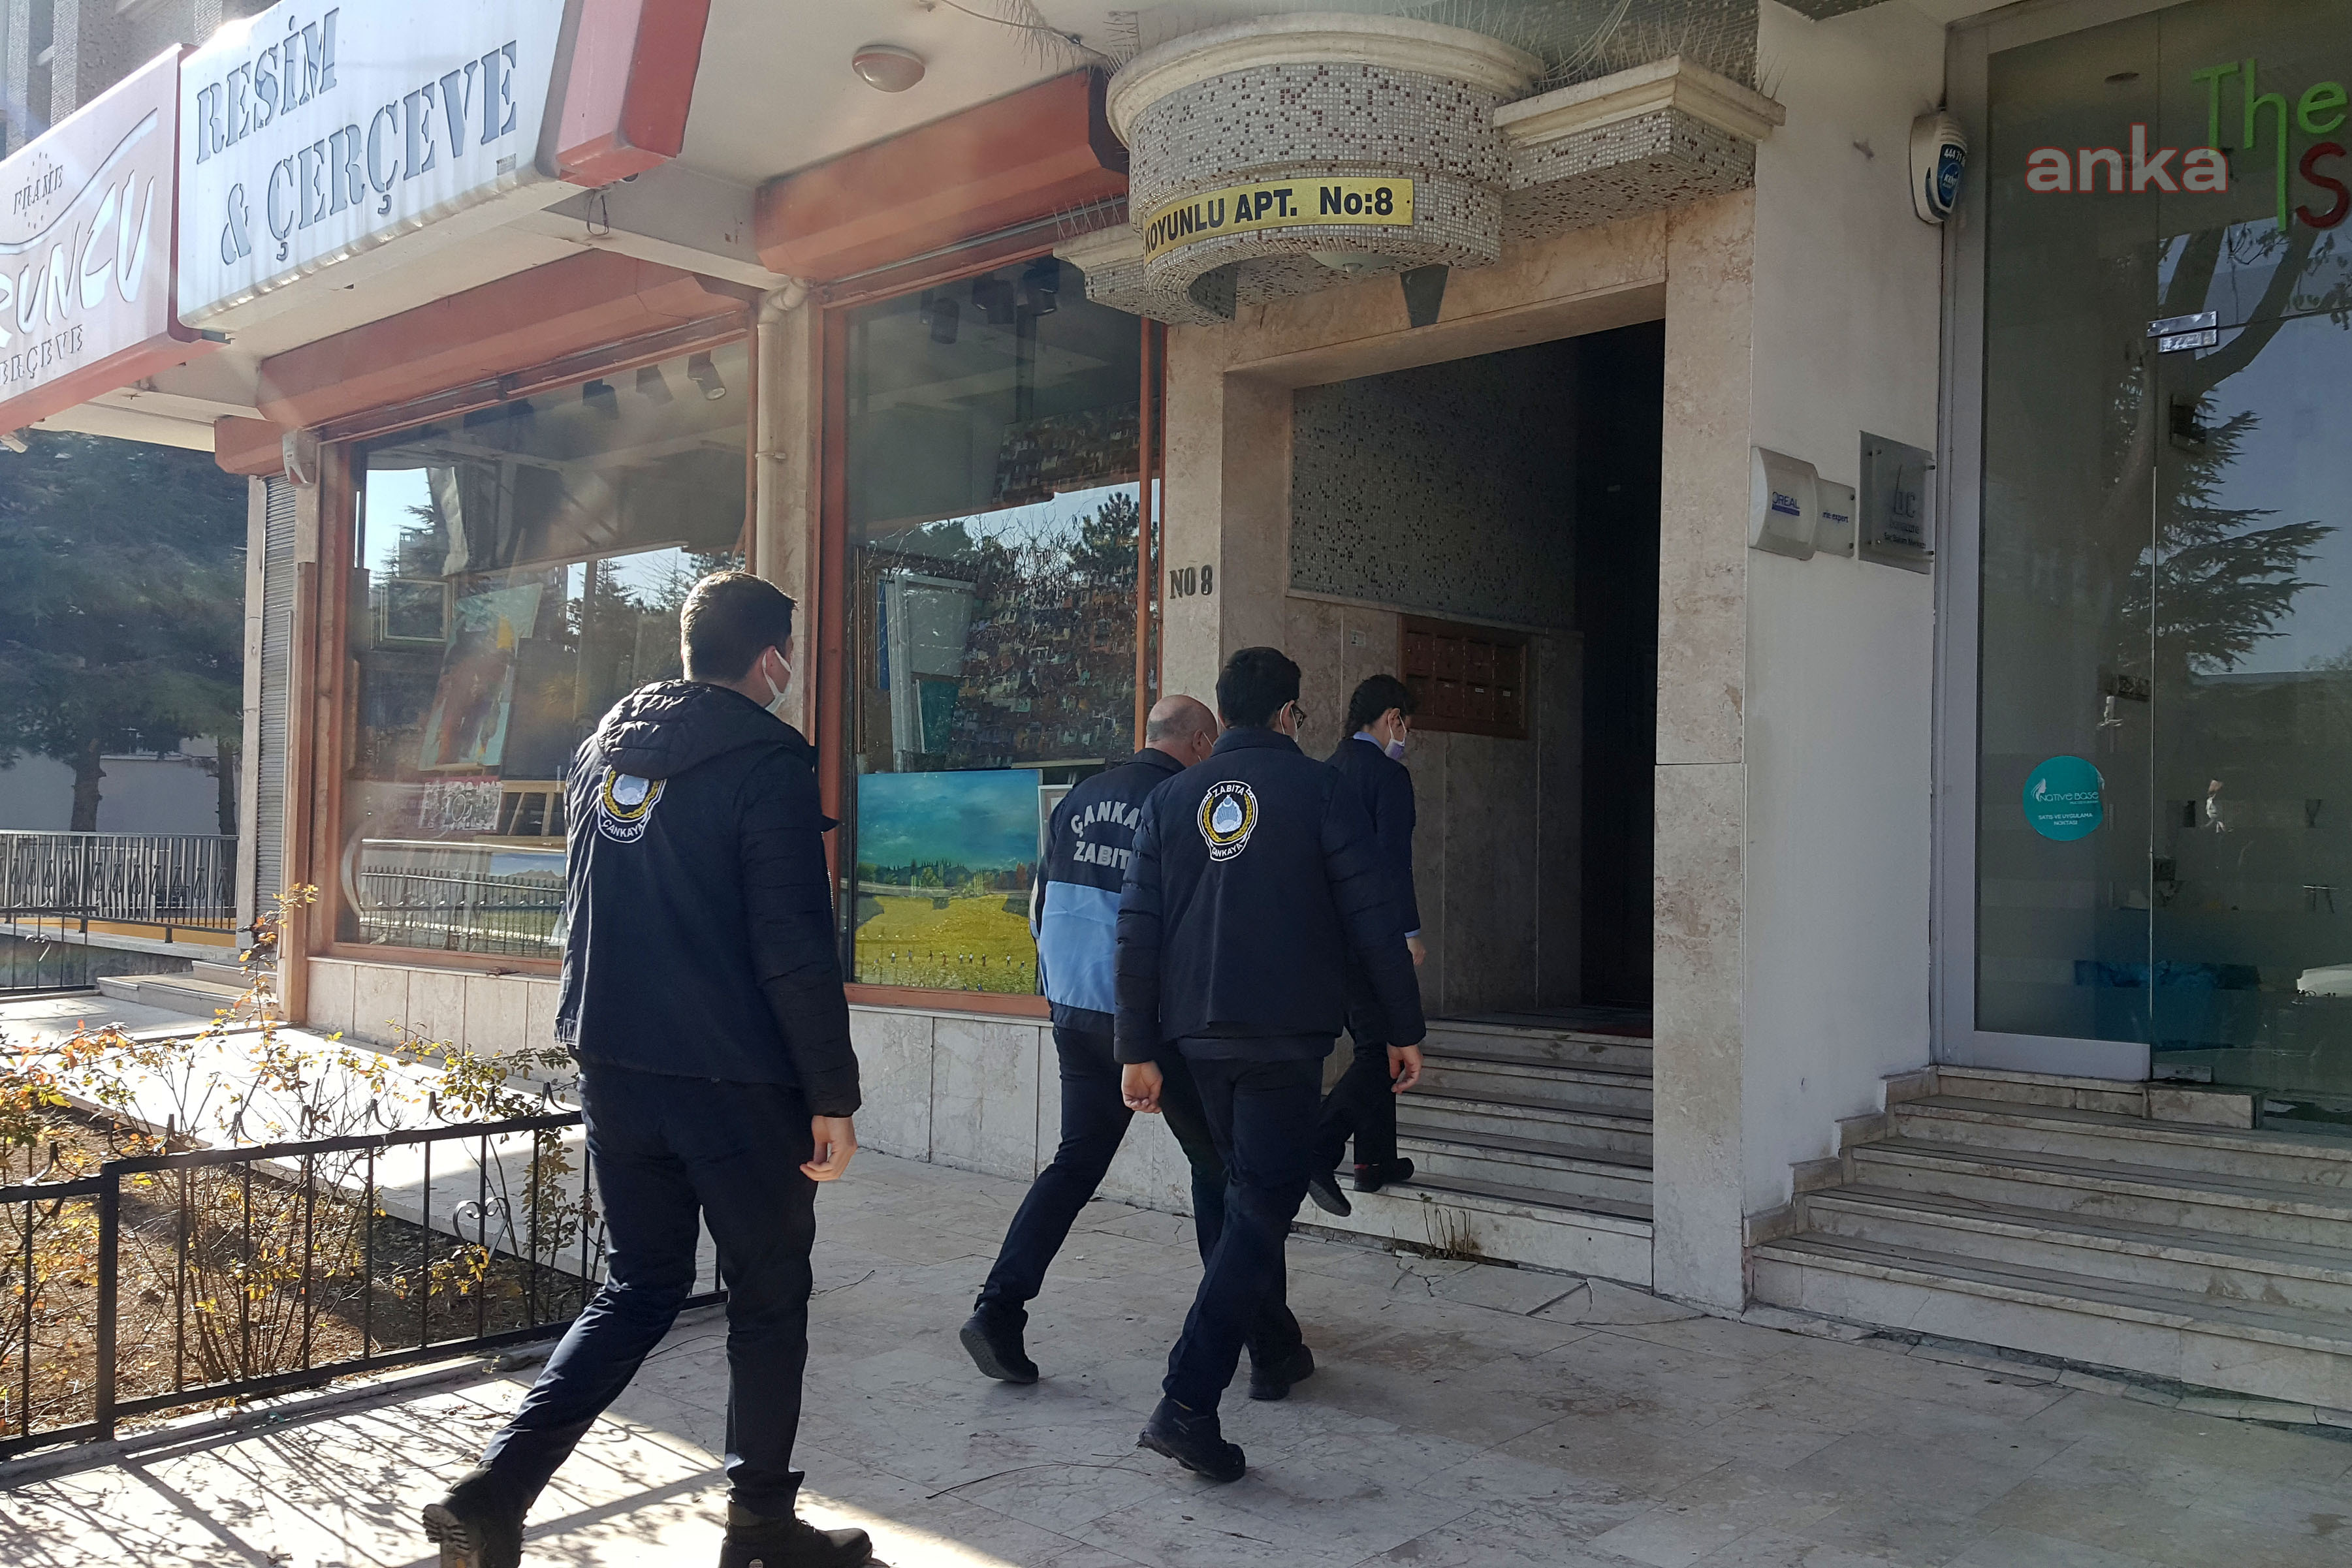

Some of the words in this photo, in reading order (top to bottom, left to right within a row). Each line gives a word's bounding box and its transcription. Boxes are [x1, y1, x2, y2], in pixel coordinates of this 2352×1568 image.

[197, 7, 340, 165] RESİM
[221, 183, 253, 266] &
[267, 40, 518, 261] ÇERÇEVE
[2191, 57, 2349, 232] The
[13, 164, 63, 215] FRAME
[1145, 198, 1224, 257] KOYUNLU
[1234, 188, 1297, 223] APT.
[1320, 186, 1393, 216] No:8
[1169, 567, 1196, 599] NO
[1201, 564, 1213, 596] 8
[1212, 784, 1245, 798] ZABITA
[601, 819, 644, 838] ÇANKAYA
